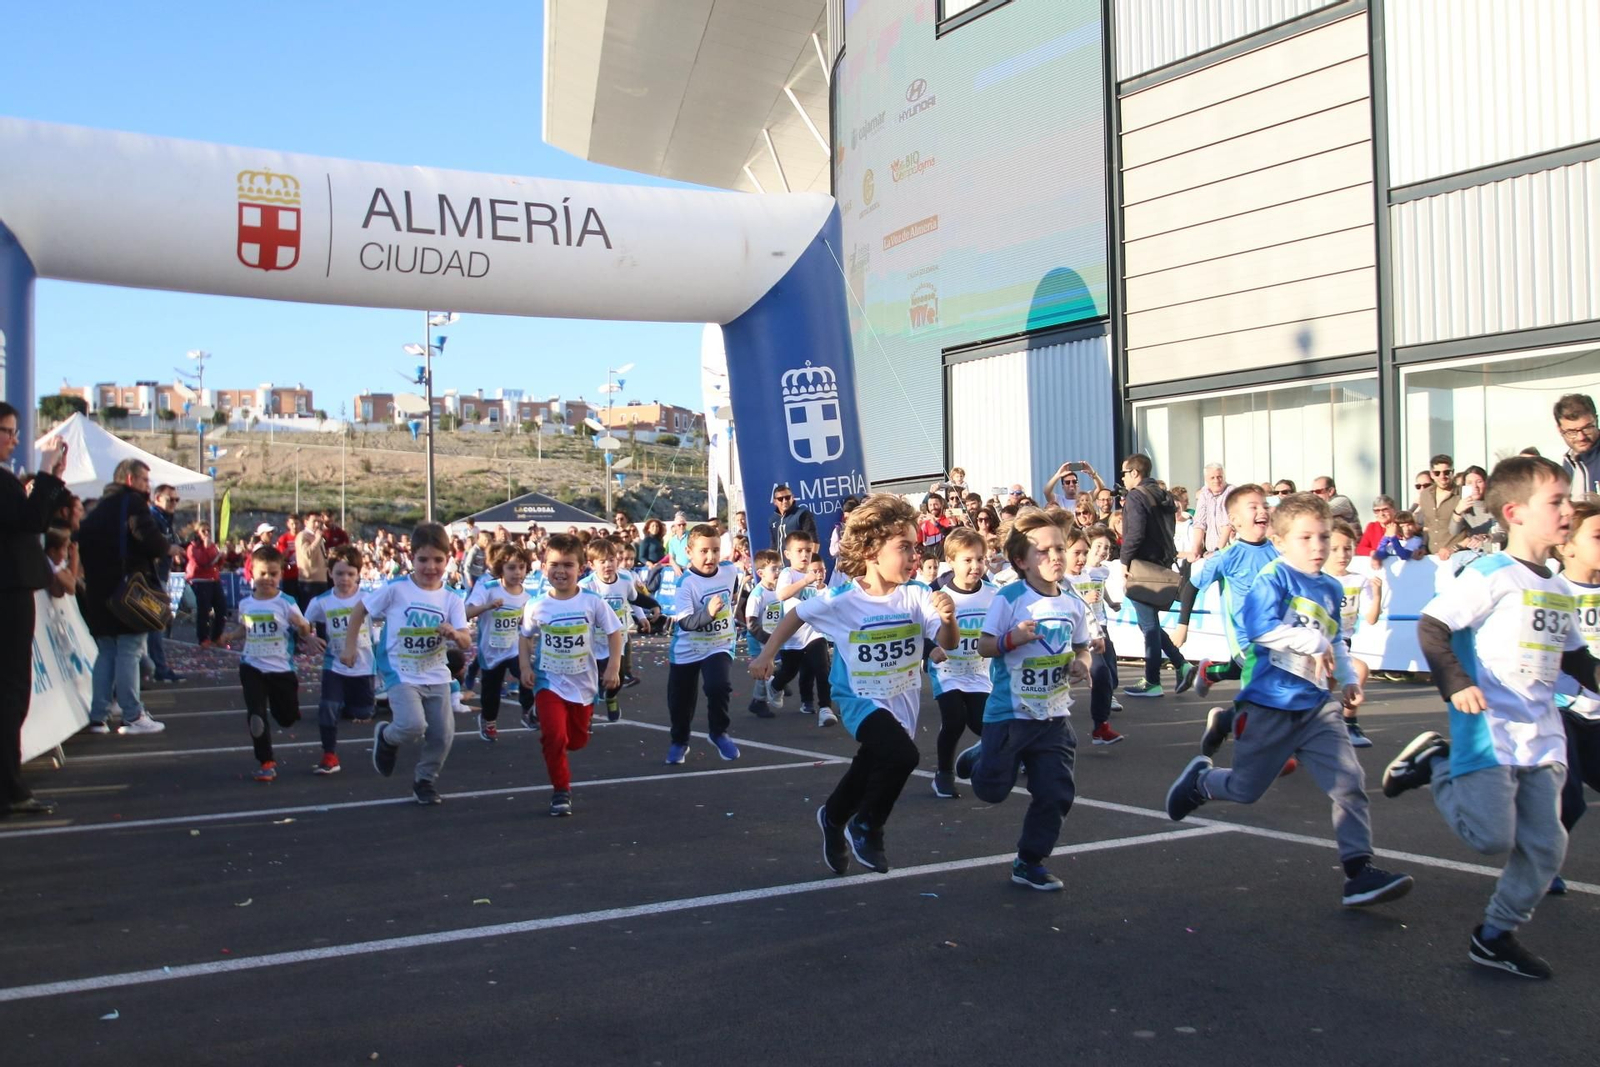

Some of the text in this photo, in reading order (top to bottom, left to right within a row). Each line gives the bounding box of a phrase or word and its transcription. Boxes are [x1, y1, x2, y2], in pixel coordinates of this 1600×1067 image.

[898, 94, 937, 122] HYUNDAI
[361, 186, 613, 250] ALMERÍA
[359, 241, 491, 279] CIUDAD
[332, 615, 348, 628] 81
[862, 612, 911, 624] SUPER RUNNER
[544, 633, 586, 650] 8354
[858, 637, 917, 663] 8355
[880, 660, 898, 669] FRAN
[1021, 685, 1047, 693] CARLOS
